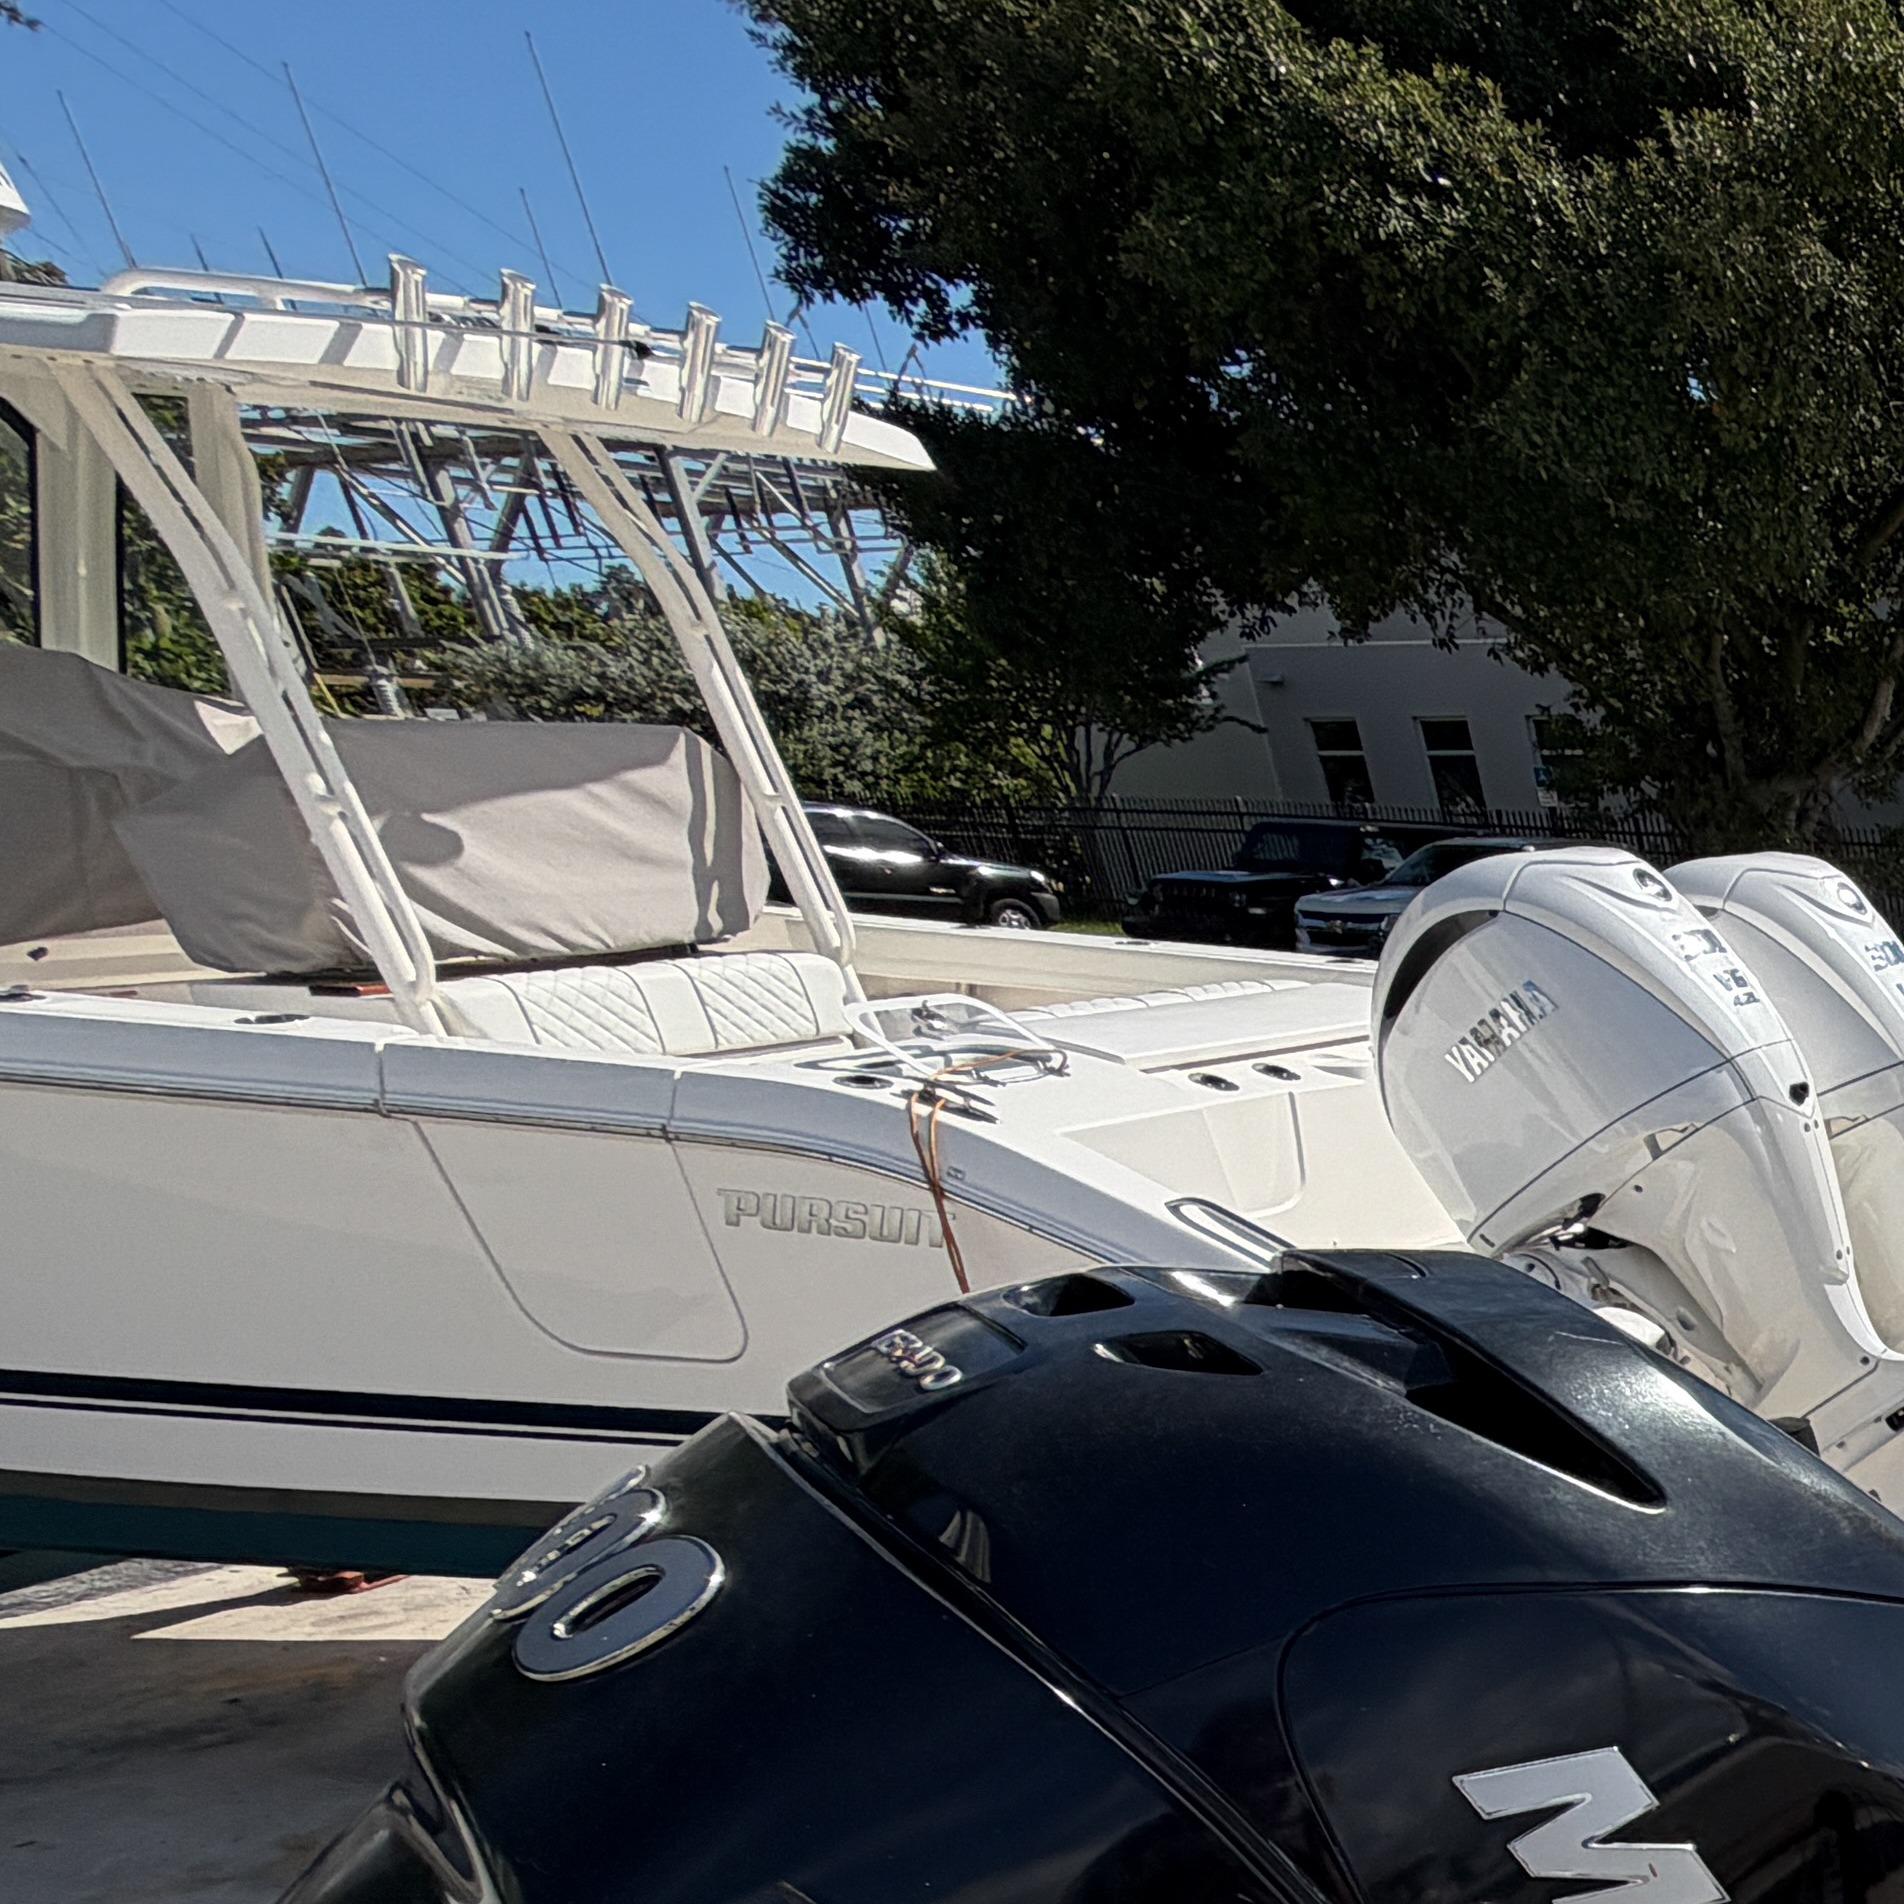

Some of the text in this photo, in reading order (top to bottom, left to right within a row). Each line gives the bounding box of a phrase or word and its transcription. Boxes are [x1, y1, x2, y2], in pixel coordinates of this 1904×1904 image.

[1444, 980, 1560, 1084] YAMAHA
[716, 1187, 956, 1249] PURSUIT
[491, 1463, 726, 1682] 00
